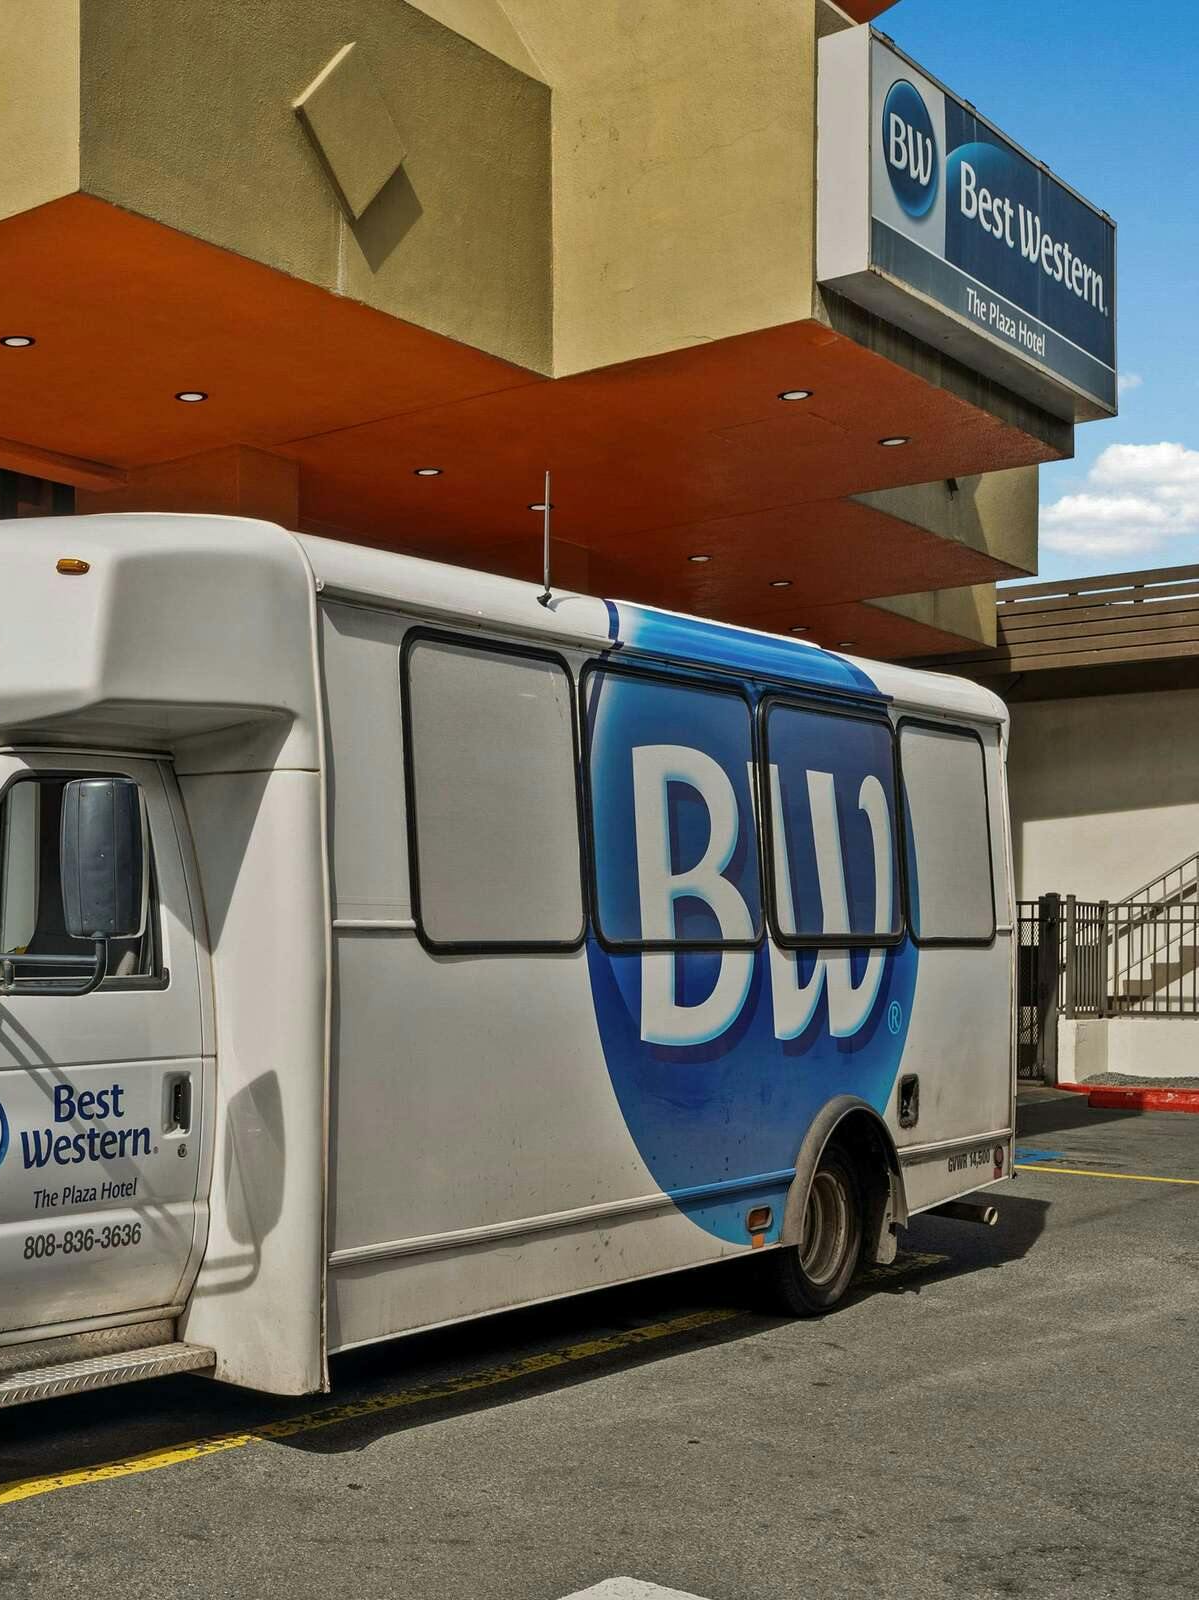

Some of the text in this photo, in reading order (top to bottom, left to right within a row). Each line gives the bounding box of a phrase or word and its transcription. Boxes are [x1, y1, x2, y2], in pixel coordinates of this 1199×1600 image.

[889, 112, 933, 187] BW
[960, 160, 1014, 247] Best
[966, 287, 1046, 356] The Plaza Hotel
[631, 743, 893, 1047] BW
[54, 1084, 124, 1123] Best
[948, 1153, 968, 1172] GVWR
[33, 1177, 138, 1209] The Plaza Hotel
[23, 1222, 142, 1260] 808-836-3636
